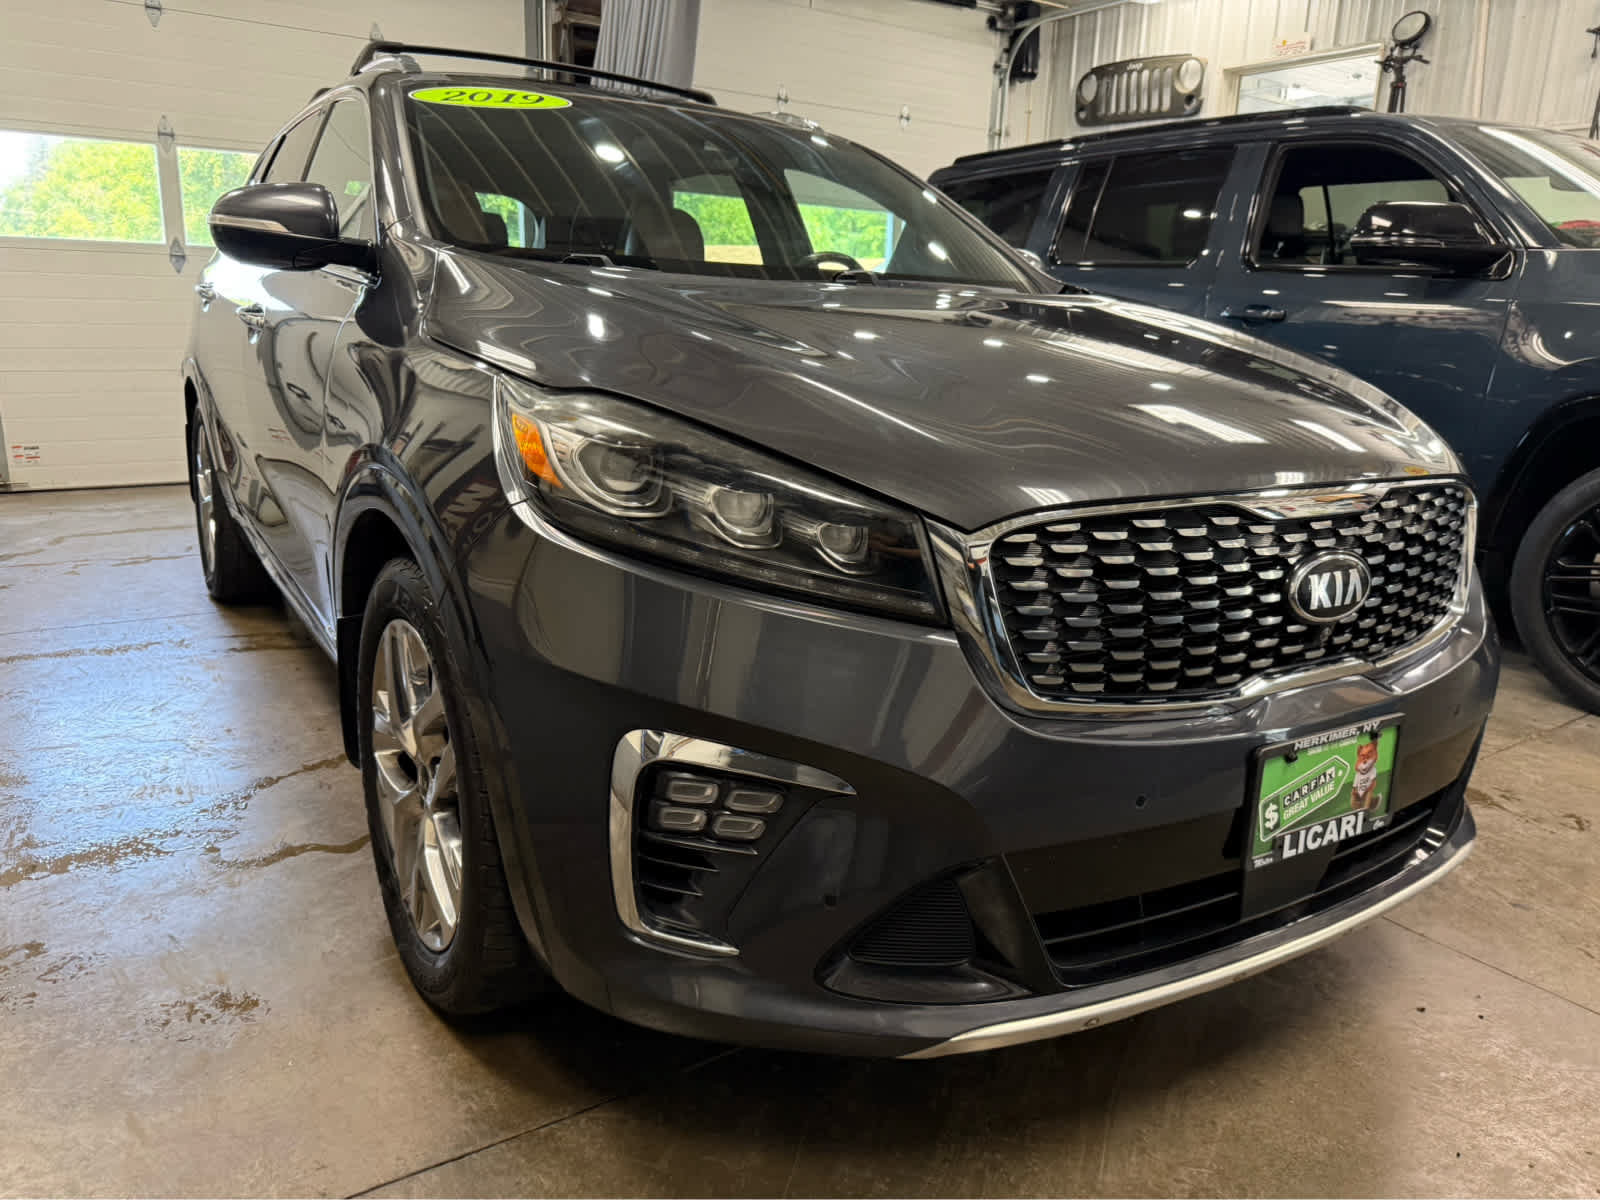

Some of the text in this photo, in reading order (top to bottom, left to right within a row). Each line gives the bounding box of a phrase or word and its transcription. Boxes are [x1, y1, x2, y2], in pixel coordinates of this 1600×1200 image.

[442, 91, 545, 105] 2019
[1308, 568, 1362, 610] KIA
[1363, 720, 1380, 733] NY
[1283, 767, 1336, 808] CARFAX
[1283, 798, 1309, 820] GREAT
[1310, 782, 1335, 803] VALUE
[1282, 812, 1364, 859] LICARI
